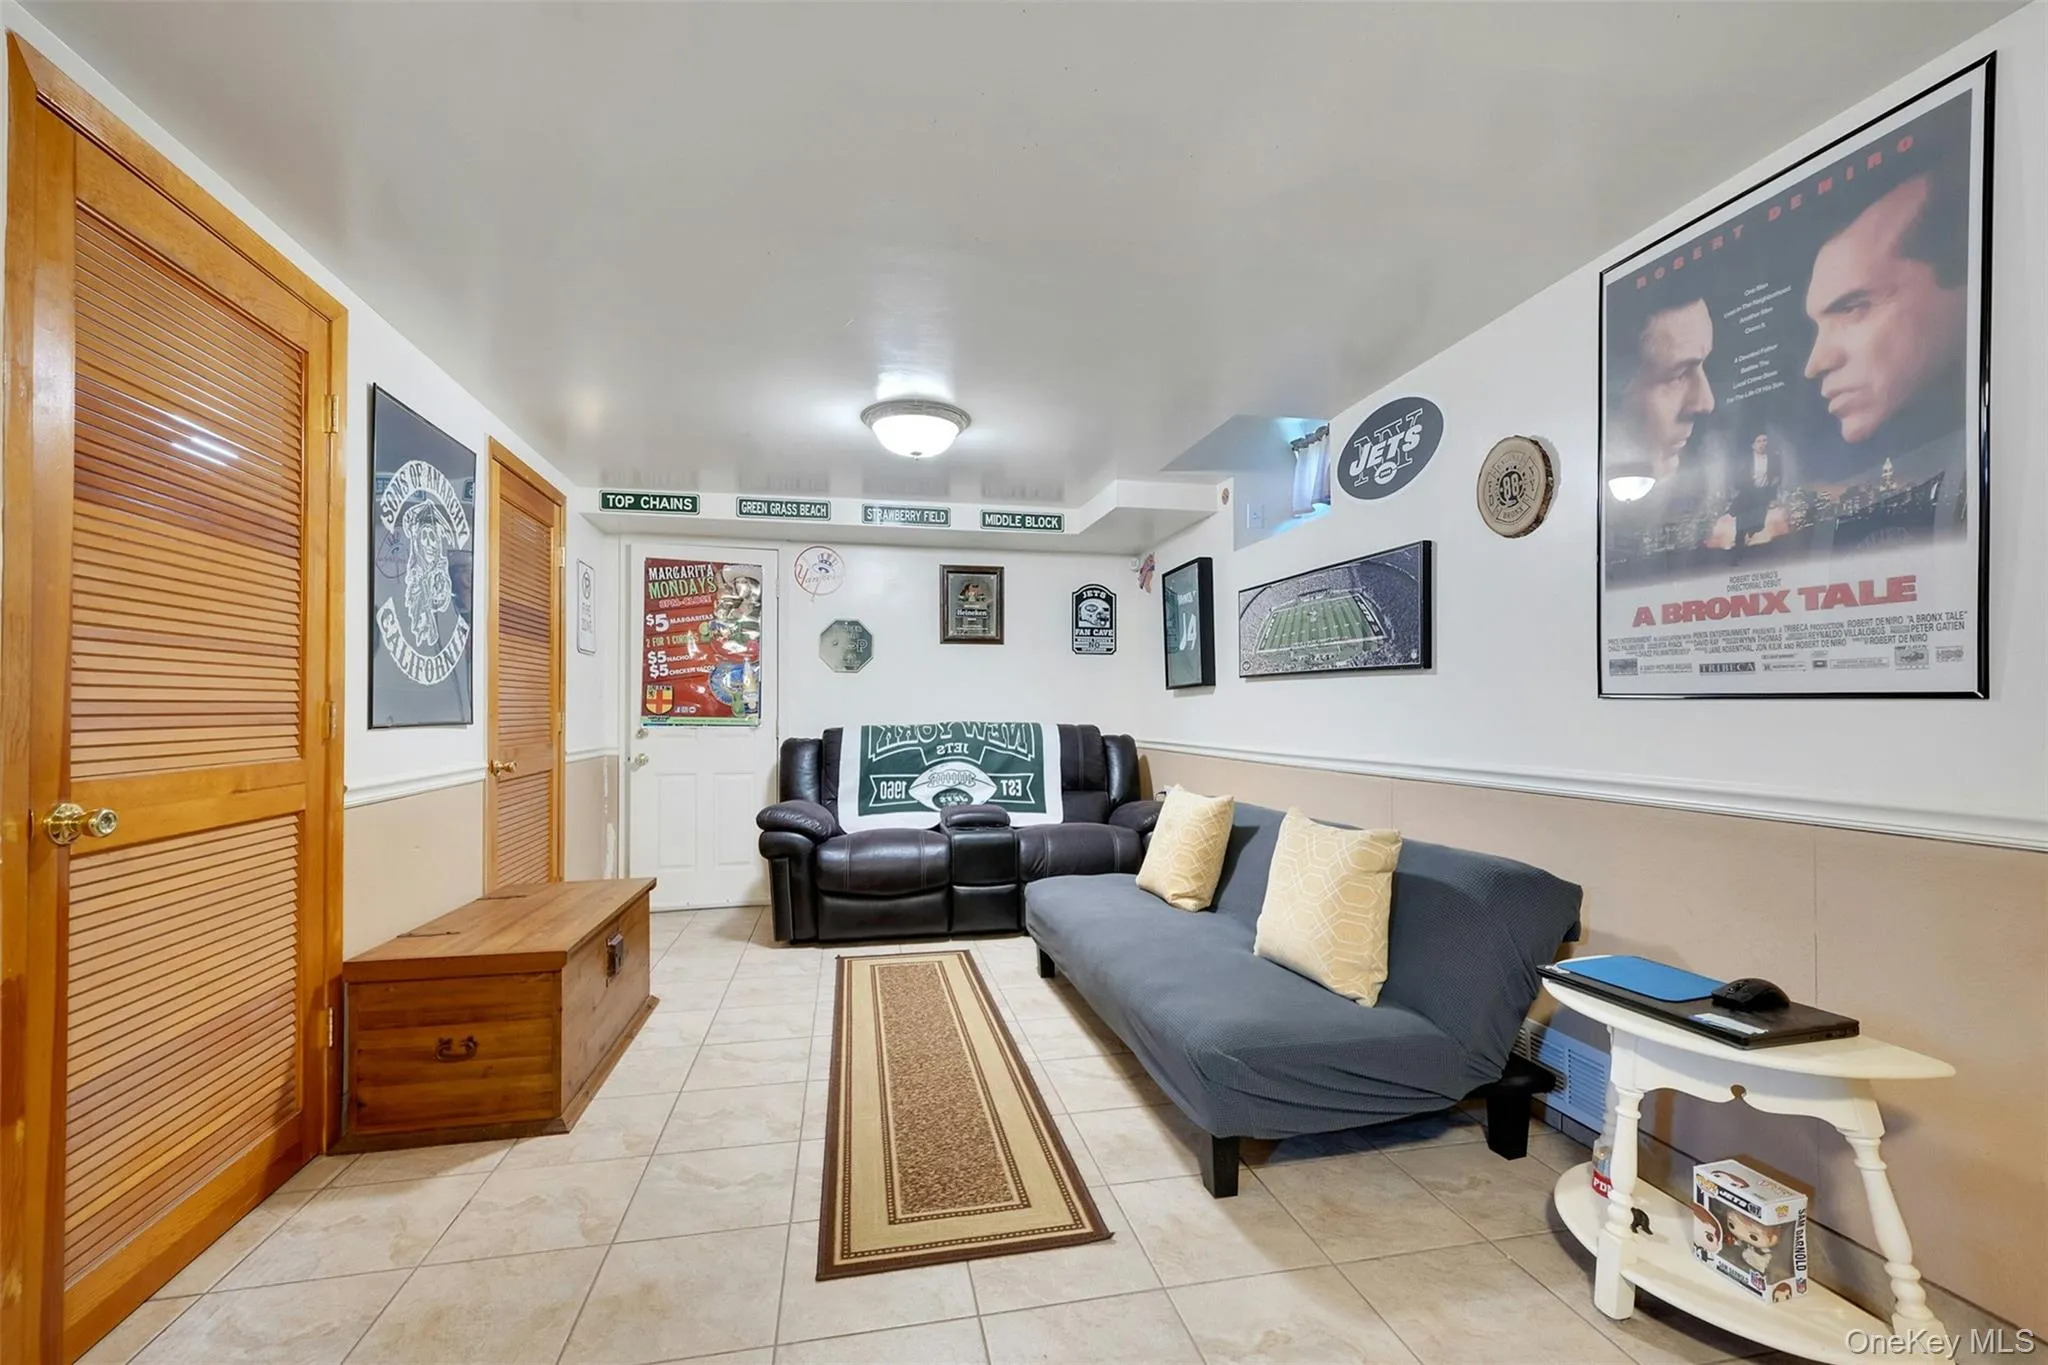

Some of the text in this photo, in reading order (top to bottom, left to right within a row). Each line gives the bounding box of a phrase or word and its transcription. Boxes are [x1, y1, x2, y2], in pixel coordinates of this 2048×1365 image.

[1636, 224, 1744, 289] ROBERT
[1349, 424, 1423, 477] JETS
[382, 462, 468, 537] SONS OF ANARCHY
[607, 494, 693, 511] TOP CHAINS
[741, 501, 827, 517] GREEN GRASS BEACH
[866, 508, 946, 523] STRAWBERRY FIELD
[985, 514, 1059, 529] MIDDLE BLOCK
[648, 564, 714, 580] MARGARITA
[1729, 574, 1751, 584] ROBERT
[648, 576, 717, 599] MONDAYS
[1727, 578, 1781, 592] DIRECTORIAL DEBUT
[1083, 590, 1107, 599] JETS
[1632, 574, 1918, 627] A BRONX TALE
[957, 608, 987, 616] Heineken
[1847, 617, 1873, 628] ROBERT
[1915, 612, 1943, 623] BRONX
[646, 613, 669, 632] $5
[1808, 629, 1843, 640] REYNALDO
[1843, 626, 1886, 637] VILLALOBOS
[1911, 623, 1935, 633] PETER
[1935, 621, 1965, 632] GATIEN
[381, 607, 468, 682] CALIFORNIA
[645, 638, 651, 648] 2
[666, 636, 671, 645] 1
[1795, 640, 1820, 649] ROBERT
[1869, 635, 1896, 645] ROBERT
[647, 651, 667, 664] $5
[649, 664, 669, 679] $5
[1701, 662, 1754, 672] TRIBECA
[1719, 1187, 1748, 1208] JETS
[1797, 1208, 1806, 1227] SAM
[1795, 1229, 1807, 1271] DARNOLD
